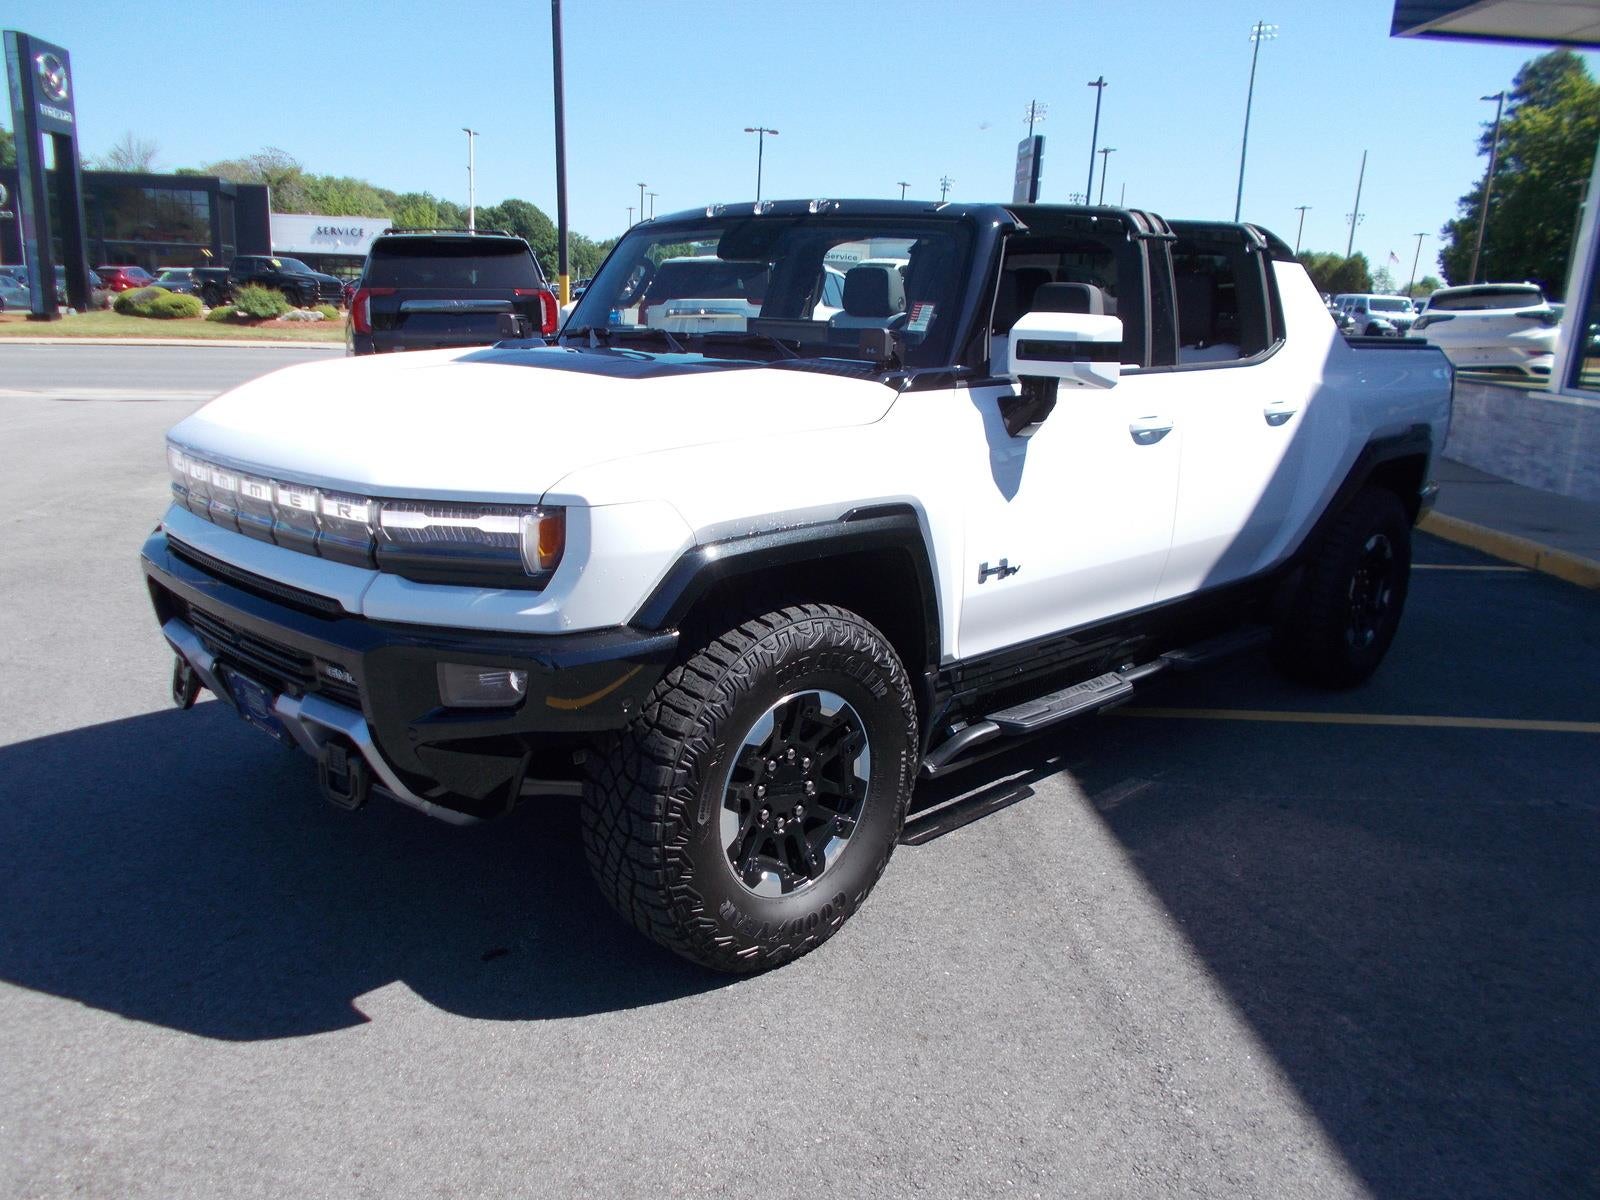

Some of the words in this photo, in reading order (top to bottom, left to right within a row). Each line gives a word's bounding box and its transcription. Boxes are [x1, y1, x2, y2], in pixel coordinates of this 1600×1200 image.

[316, 226, 364, 237] SERVICE
[825, 252, 858, 261] Service
[719, 892, 846, 940] GOODYEAR
